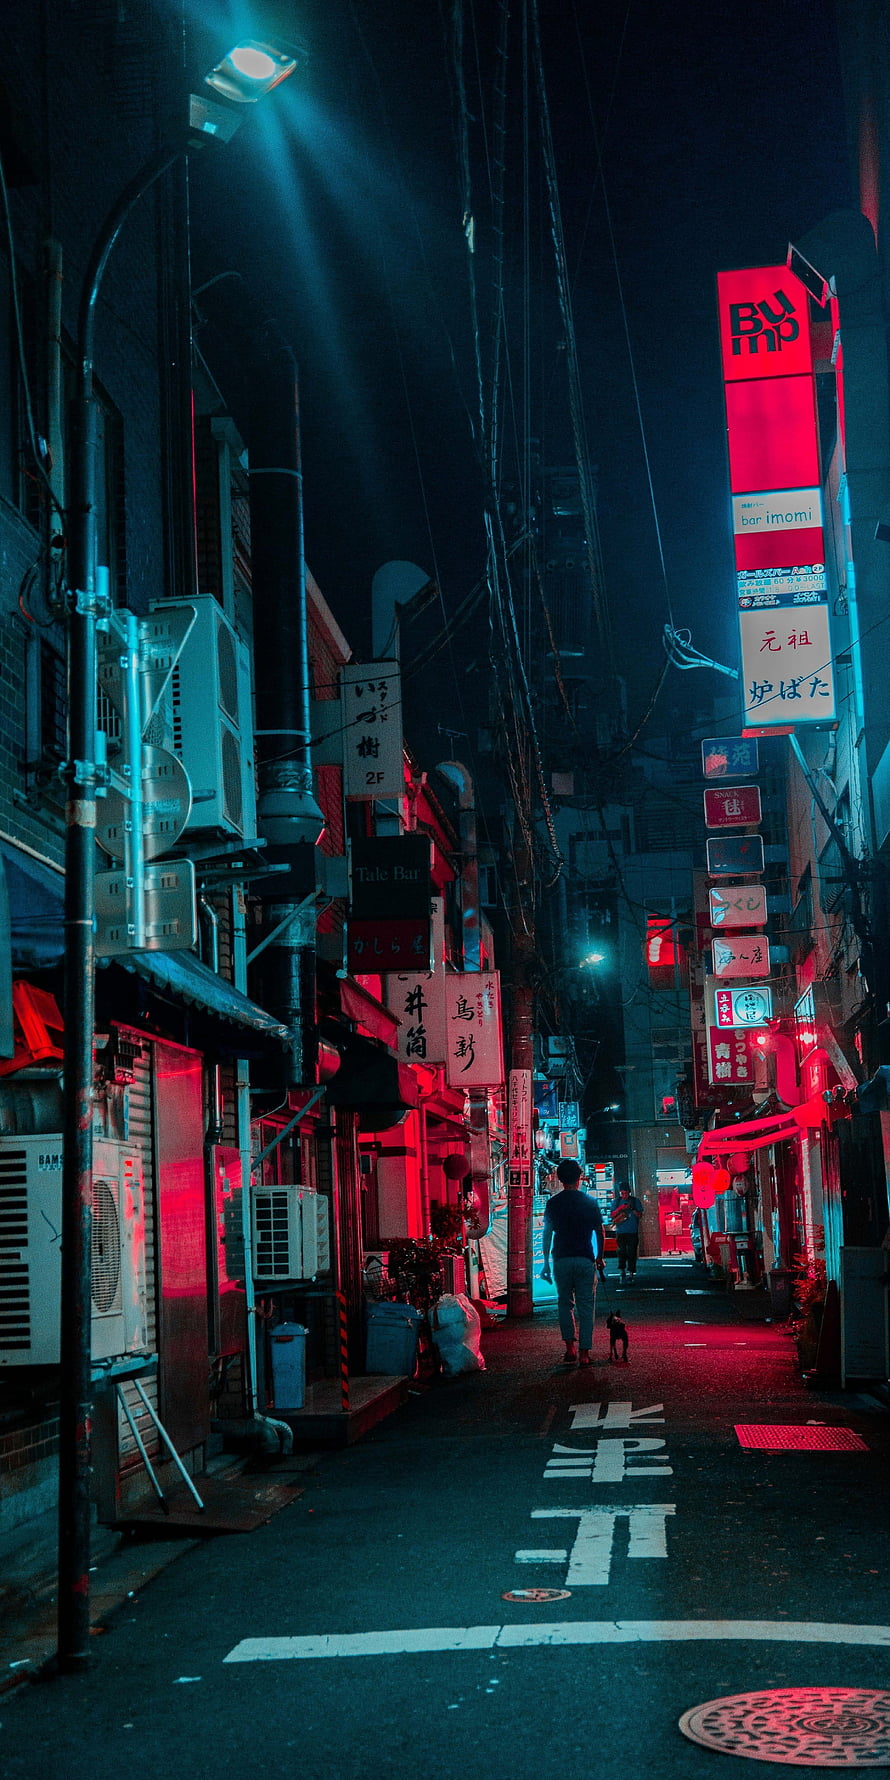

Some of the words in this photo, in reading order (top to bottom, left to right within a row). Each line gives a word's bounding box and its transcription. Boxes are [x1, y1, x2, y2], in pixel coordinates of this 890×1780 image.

[741, 515, 762, 526] bar
[766, 507, 812, 525] imomi
[759, 629, 813, 653] 元祖
[378, 681, 388, 723] スタンド
[749, 675, 831, 705] 炉ばた
[366, 771, 385, 785] 2F
[355, 866, 389, 882] Tale
[393, 865, 421, 880] Bar
[716, 897, 761, 911] つくし
[353, 935, 425, 955] かしら屋
[485, 981, 495, 1009] 水たき
[719, 993, 731, 1023] 立呑み
[475, 993, 484, 1027] やきとり
[715, 1042, 732, 1079] 青樹
